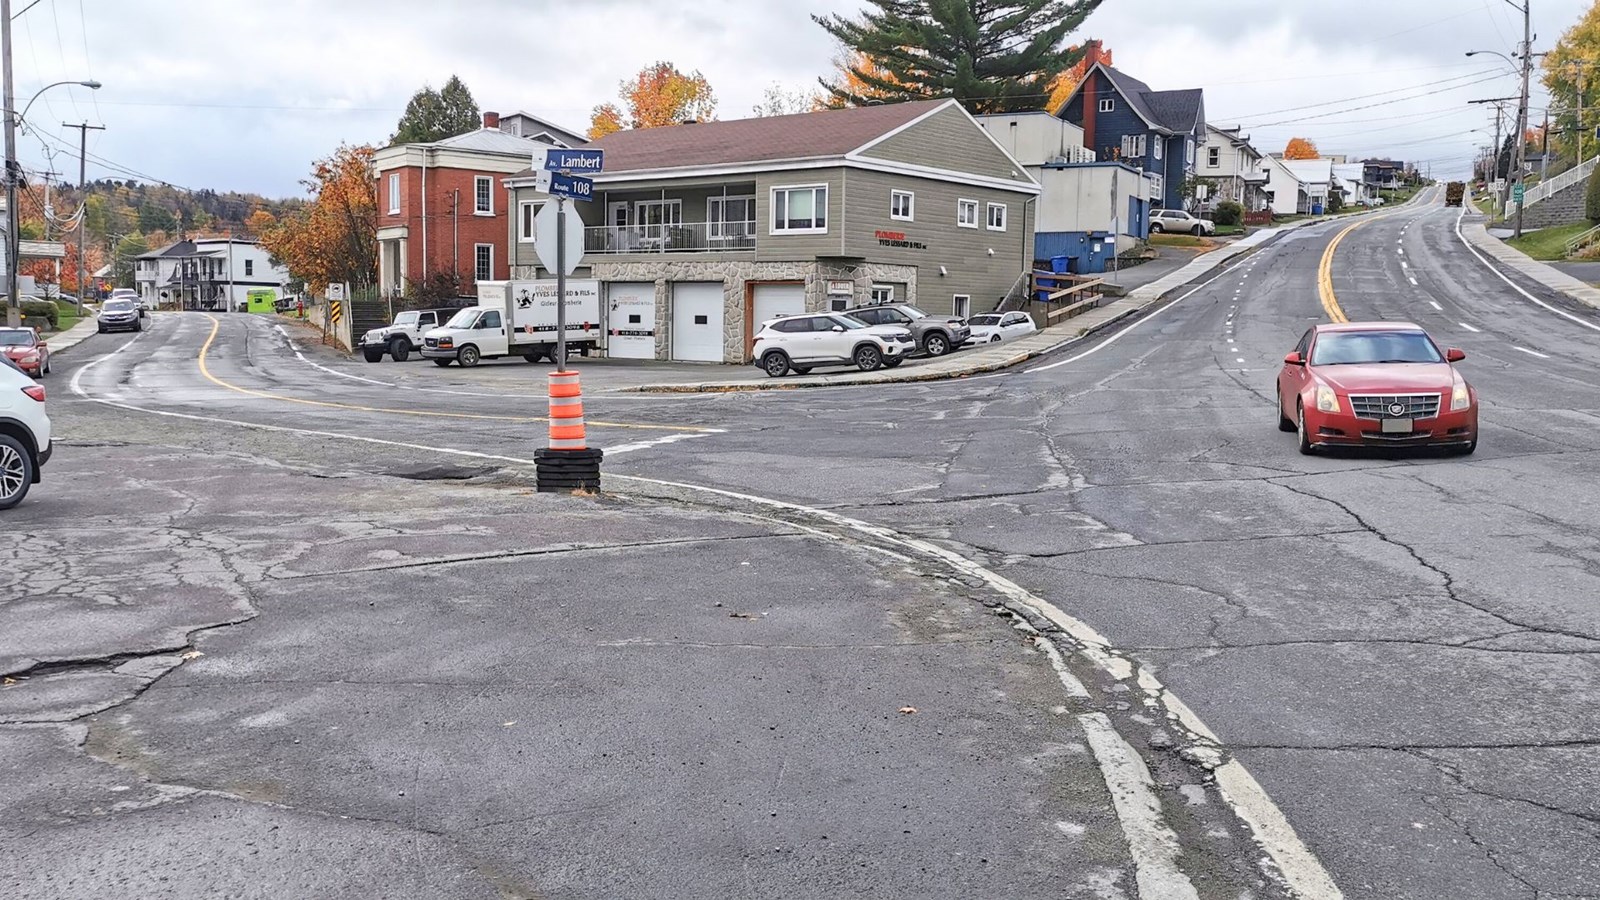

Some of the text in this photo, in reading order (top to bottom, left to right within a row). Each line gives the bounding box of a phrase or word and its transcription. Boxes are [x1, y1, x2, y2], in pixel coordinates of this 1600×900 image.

[561, 154, 600, 168] Lambert
[554, 181, 590, 195] Route 108
